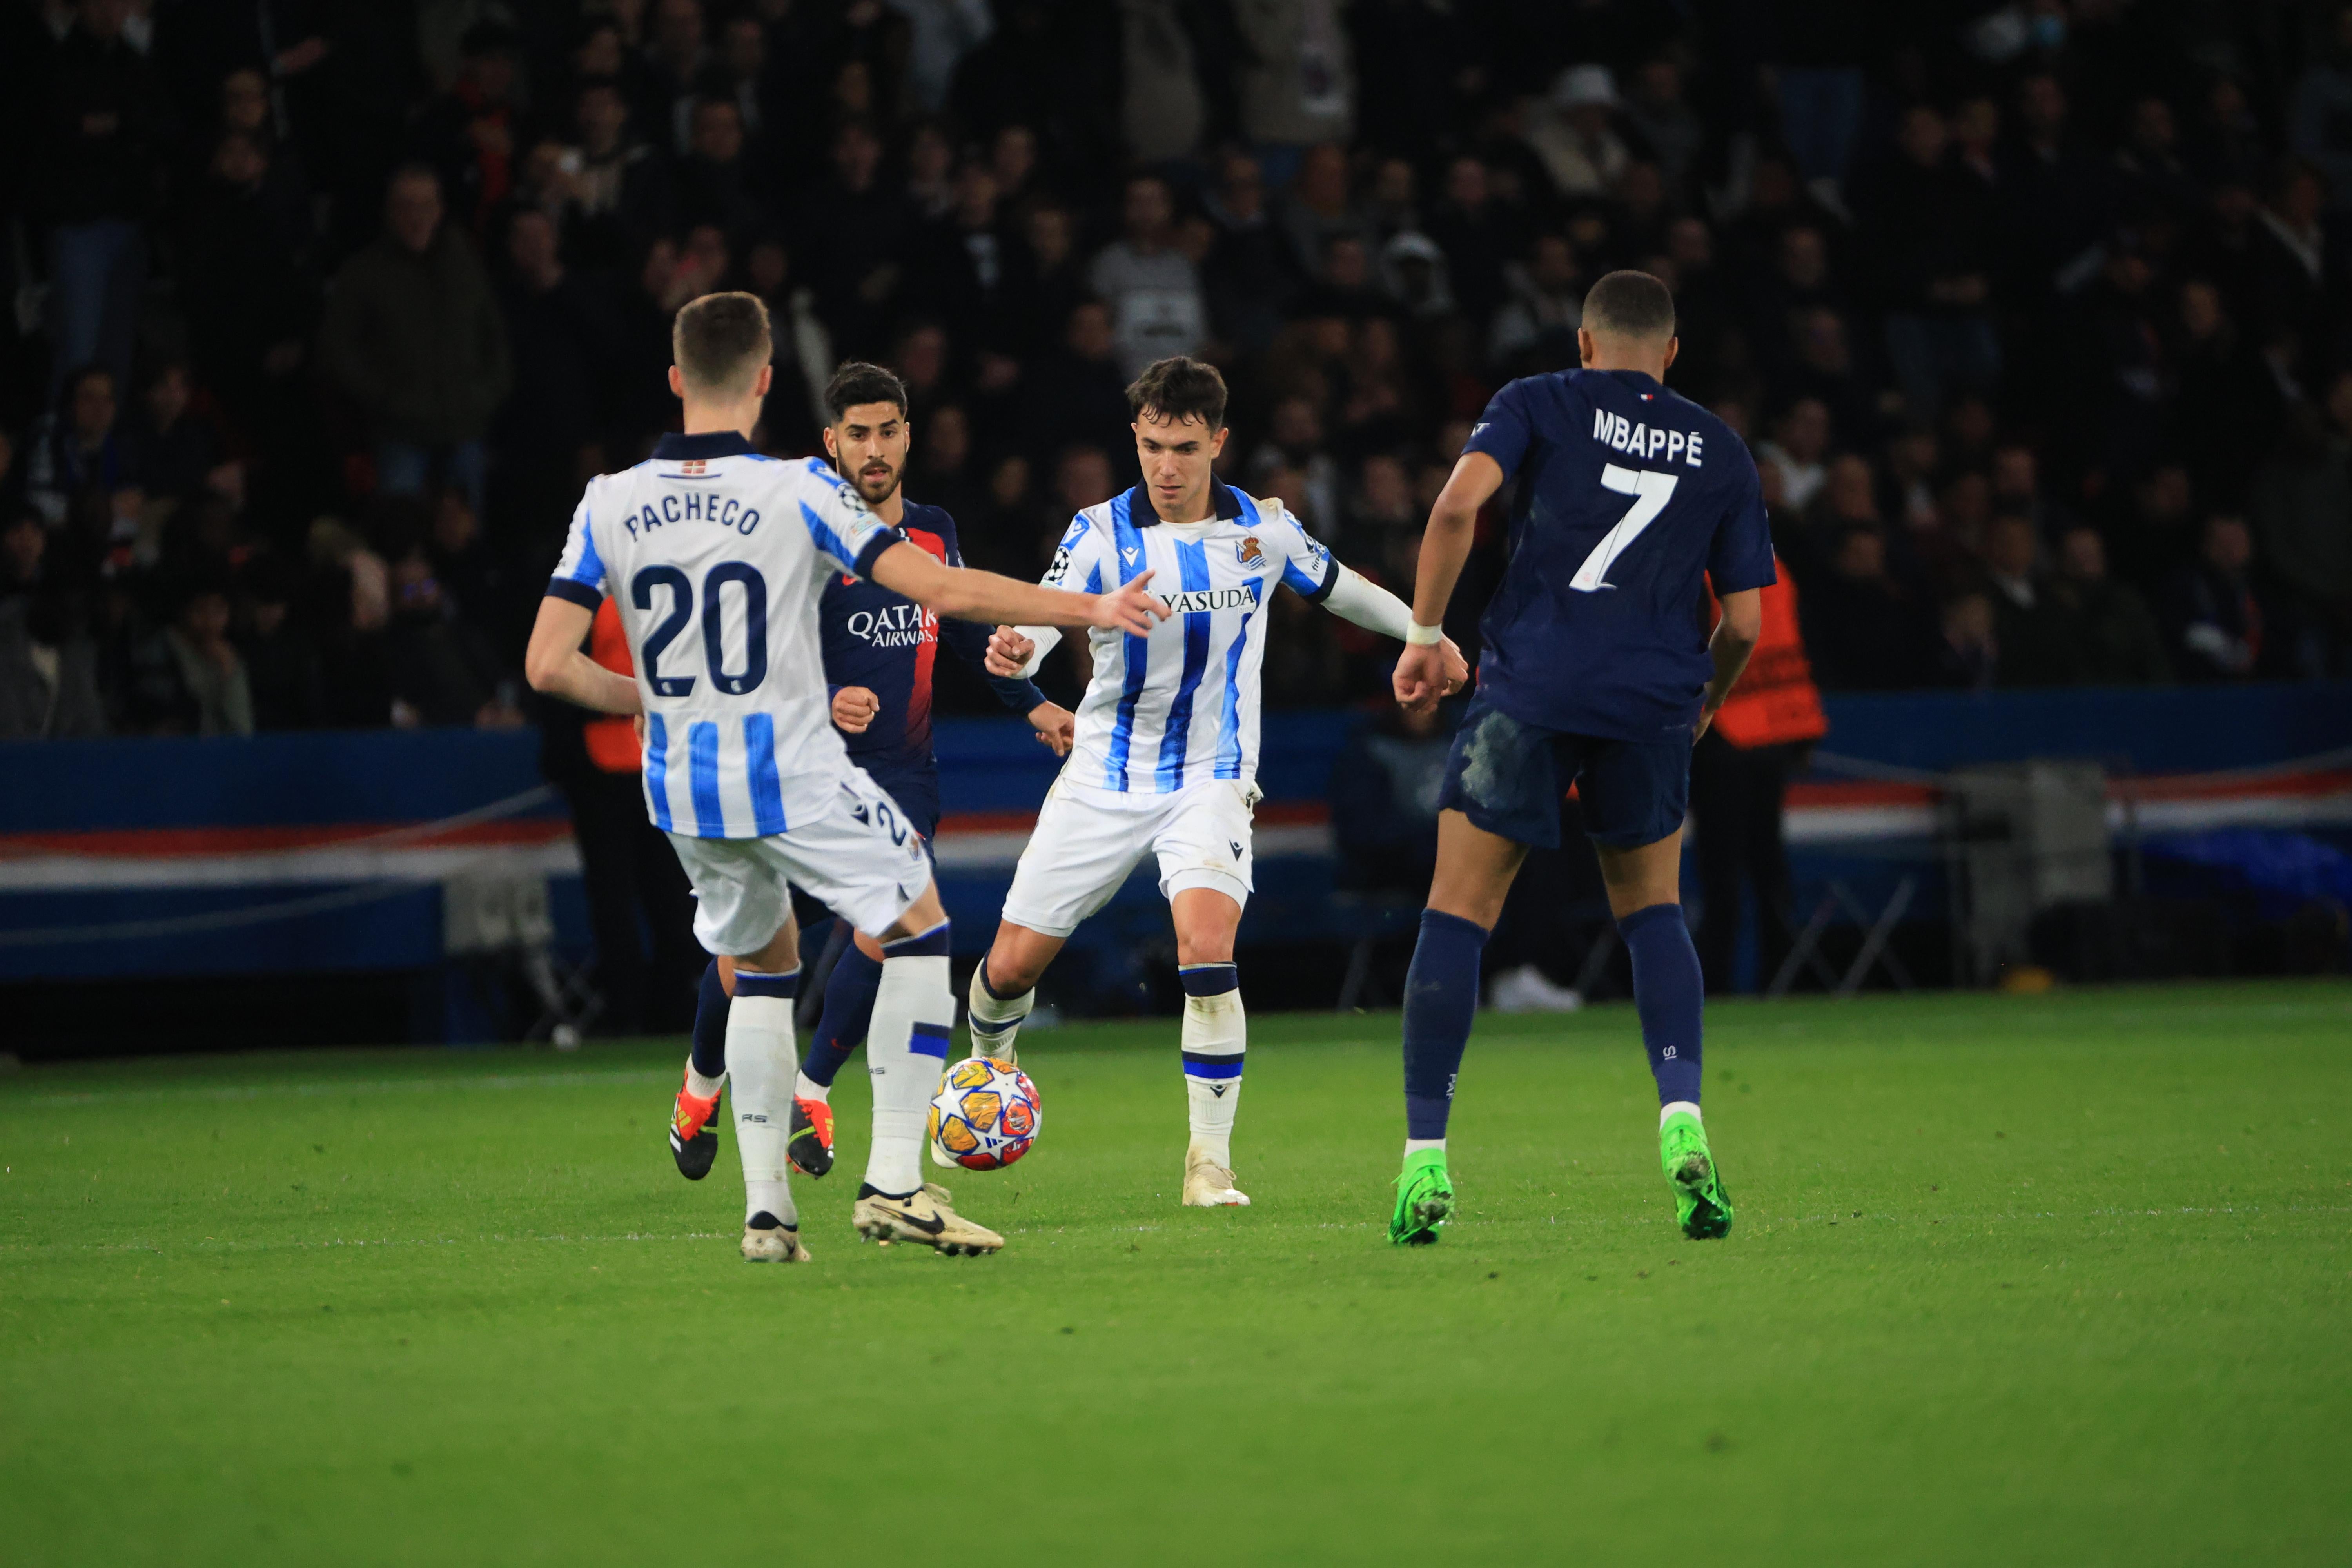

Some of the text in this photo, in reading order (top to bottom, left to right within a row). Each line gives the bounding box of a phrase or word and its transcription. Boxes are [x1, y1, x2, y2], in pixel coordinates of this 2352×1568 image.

[1593, 408, 1703, 467] MBAPPÉ
[624, 492, 760, 543] PACHECO
[1569, 462, 1679, 592] 7
[1160, 586, 1255, 612] YASUDA
[630, 561, 767, 697] 20
[877, 801, 907, 846] 2
[742, 1114, 767, 1123] RS
